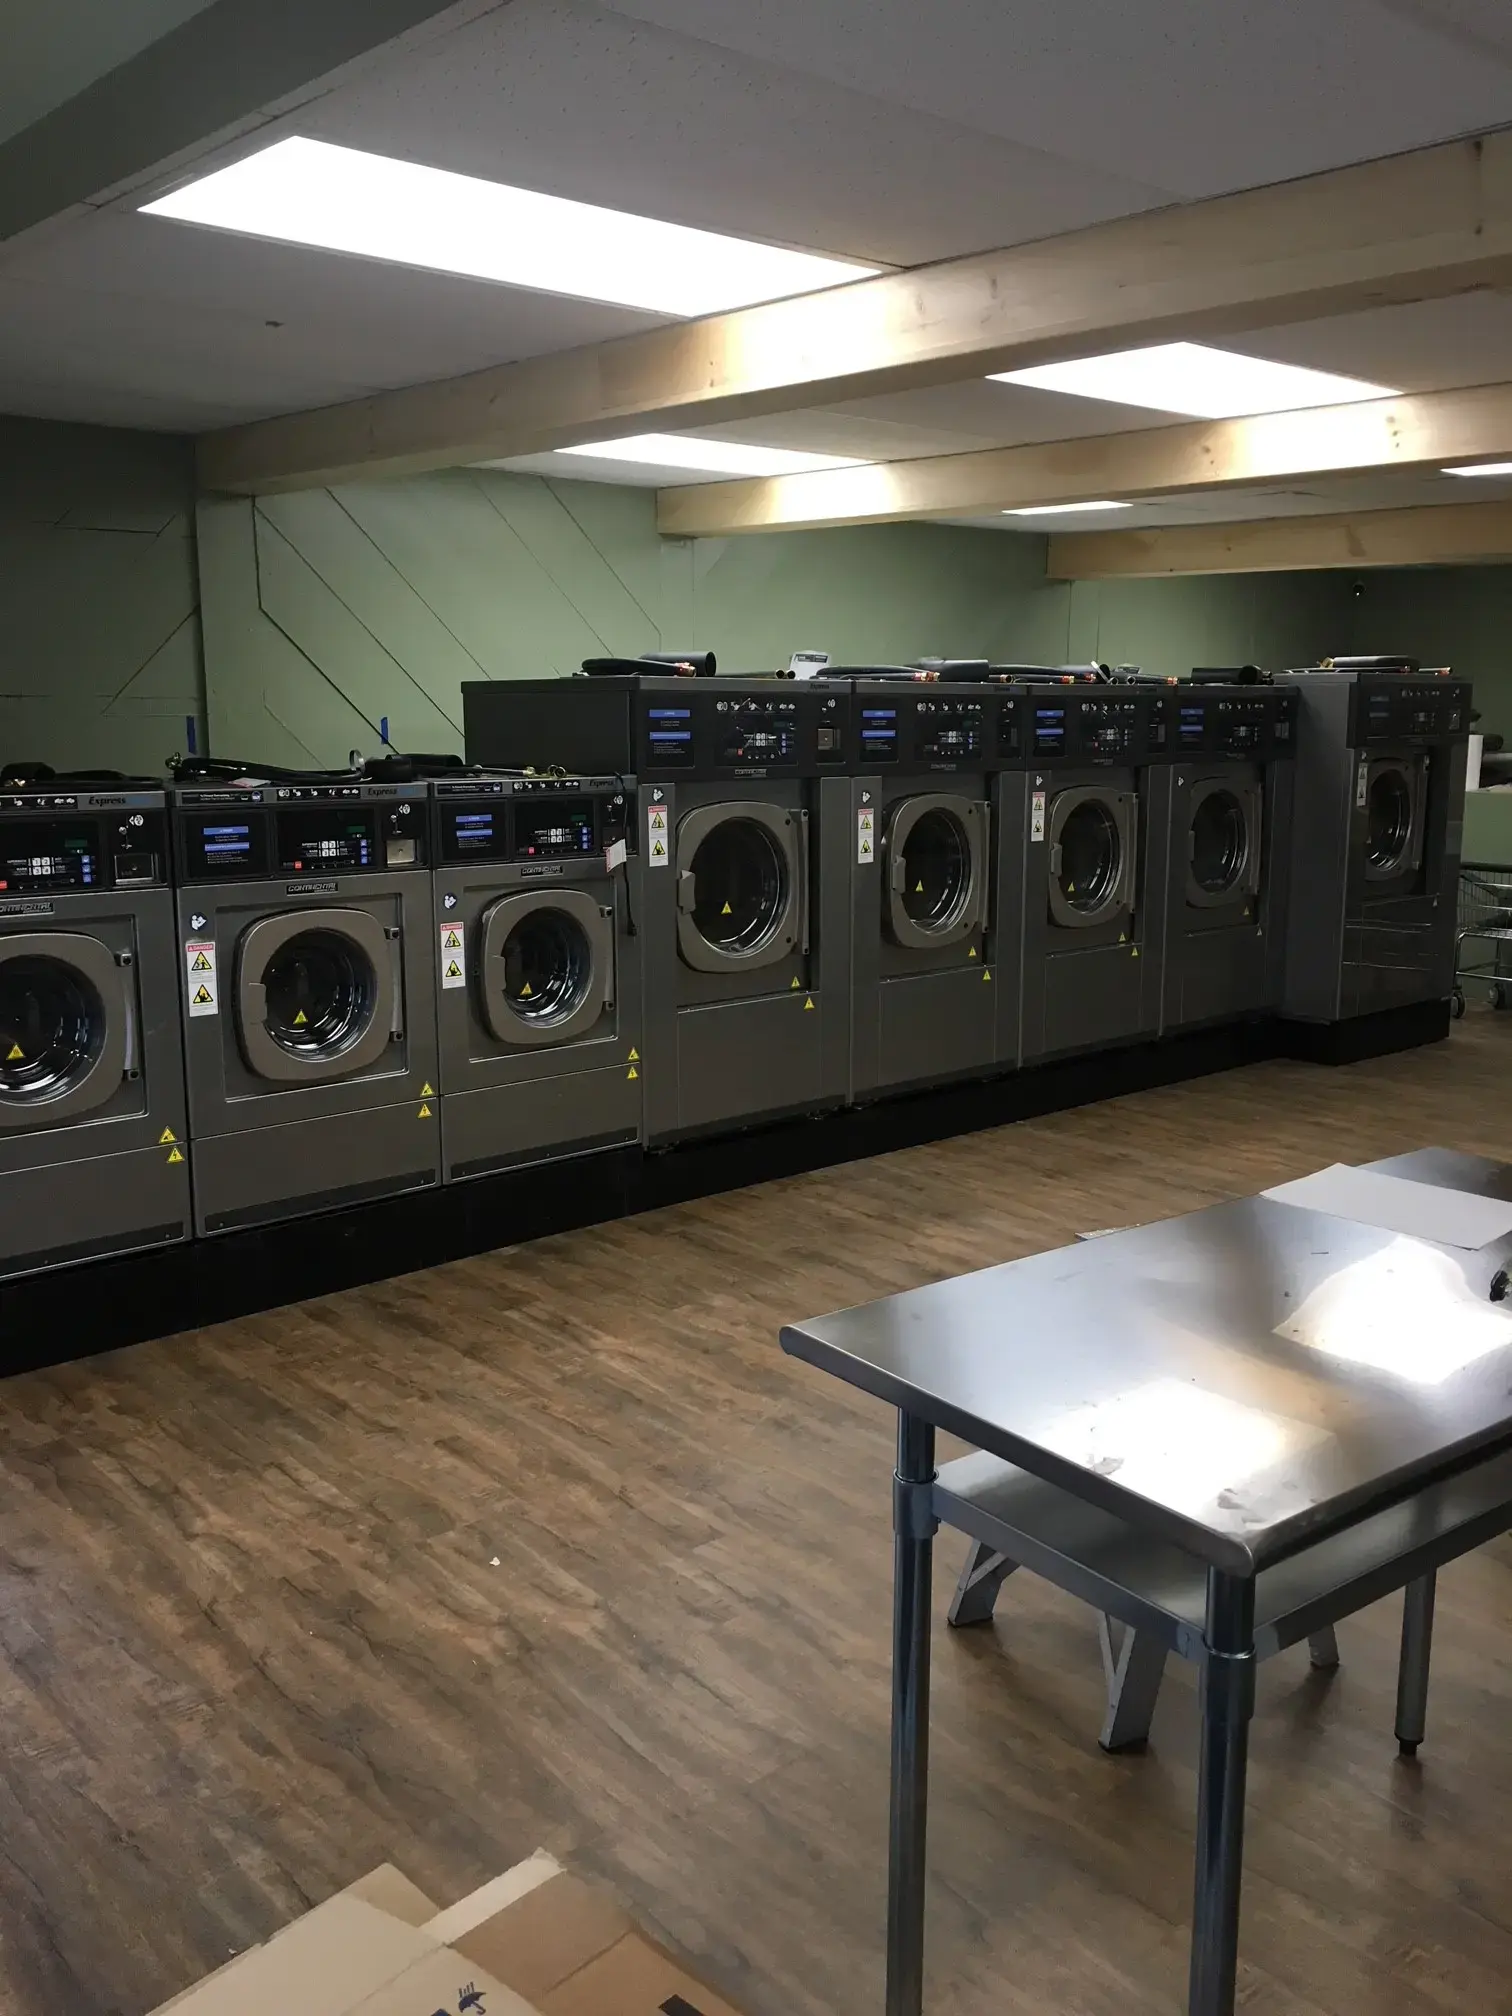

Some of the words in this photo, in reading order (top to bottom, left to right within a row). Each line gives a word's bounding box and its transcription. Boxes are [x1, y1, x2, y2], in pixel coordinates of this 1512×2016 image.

[368, 787, 398, 796] Express
[89, 796, 126, 807] Express
[0, 902, 52, 913] ONTINENTAL
